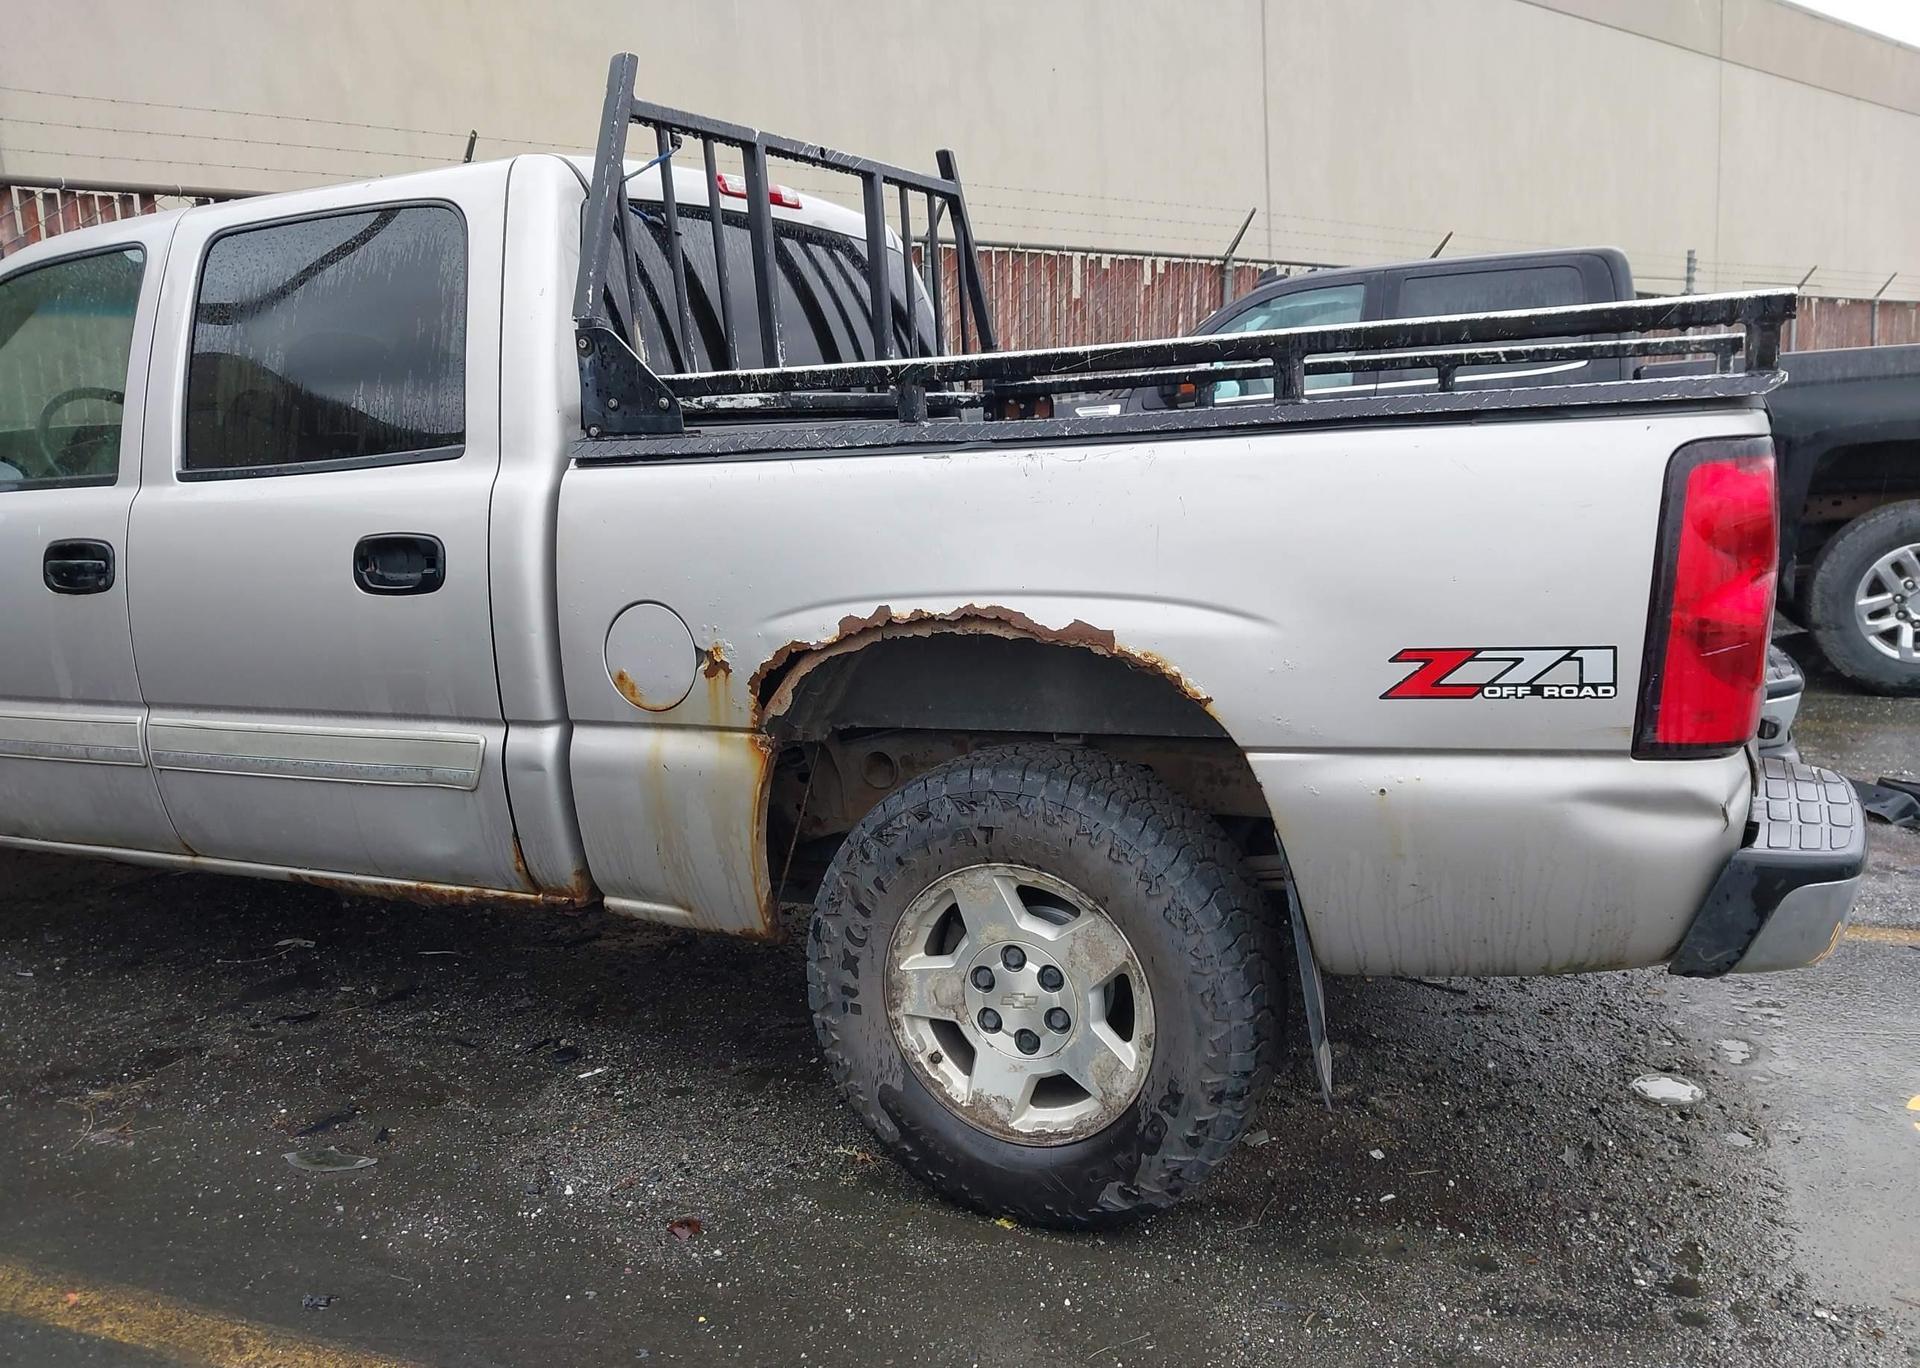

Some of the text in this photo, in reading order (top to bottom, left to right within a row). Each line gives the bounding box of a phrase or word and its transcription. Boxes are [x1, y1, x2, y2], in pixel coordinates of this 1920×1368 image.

[1379, 647, 1617, 699] Z71
[1482, 685, 1616, 699] OFF ROAD
